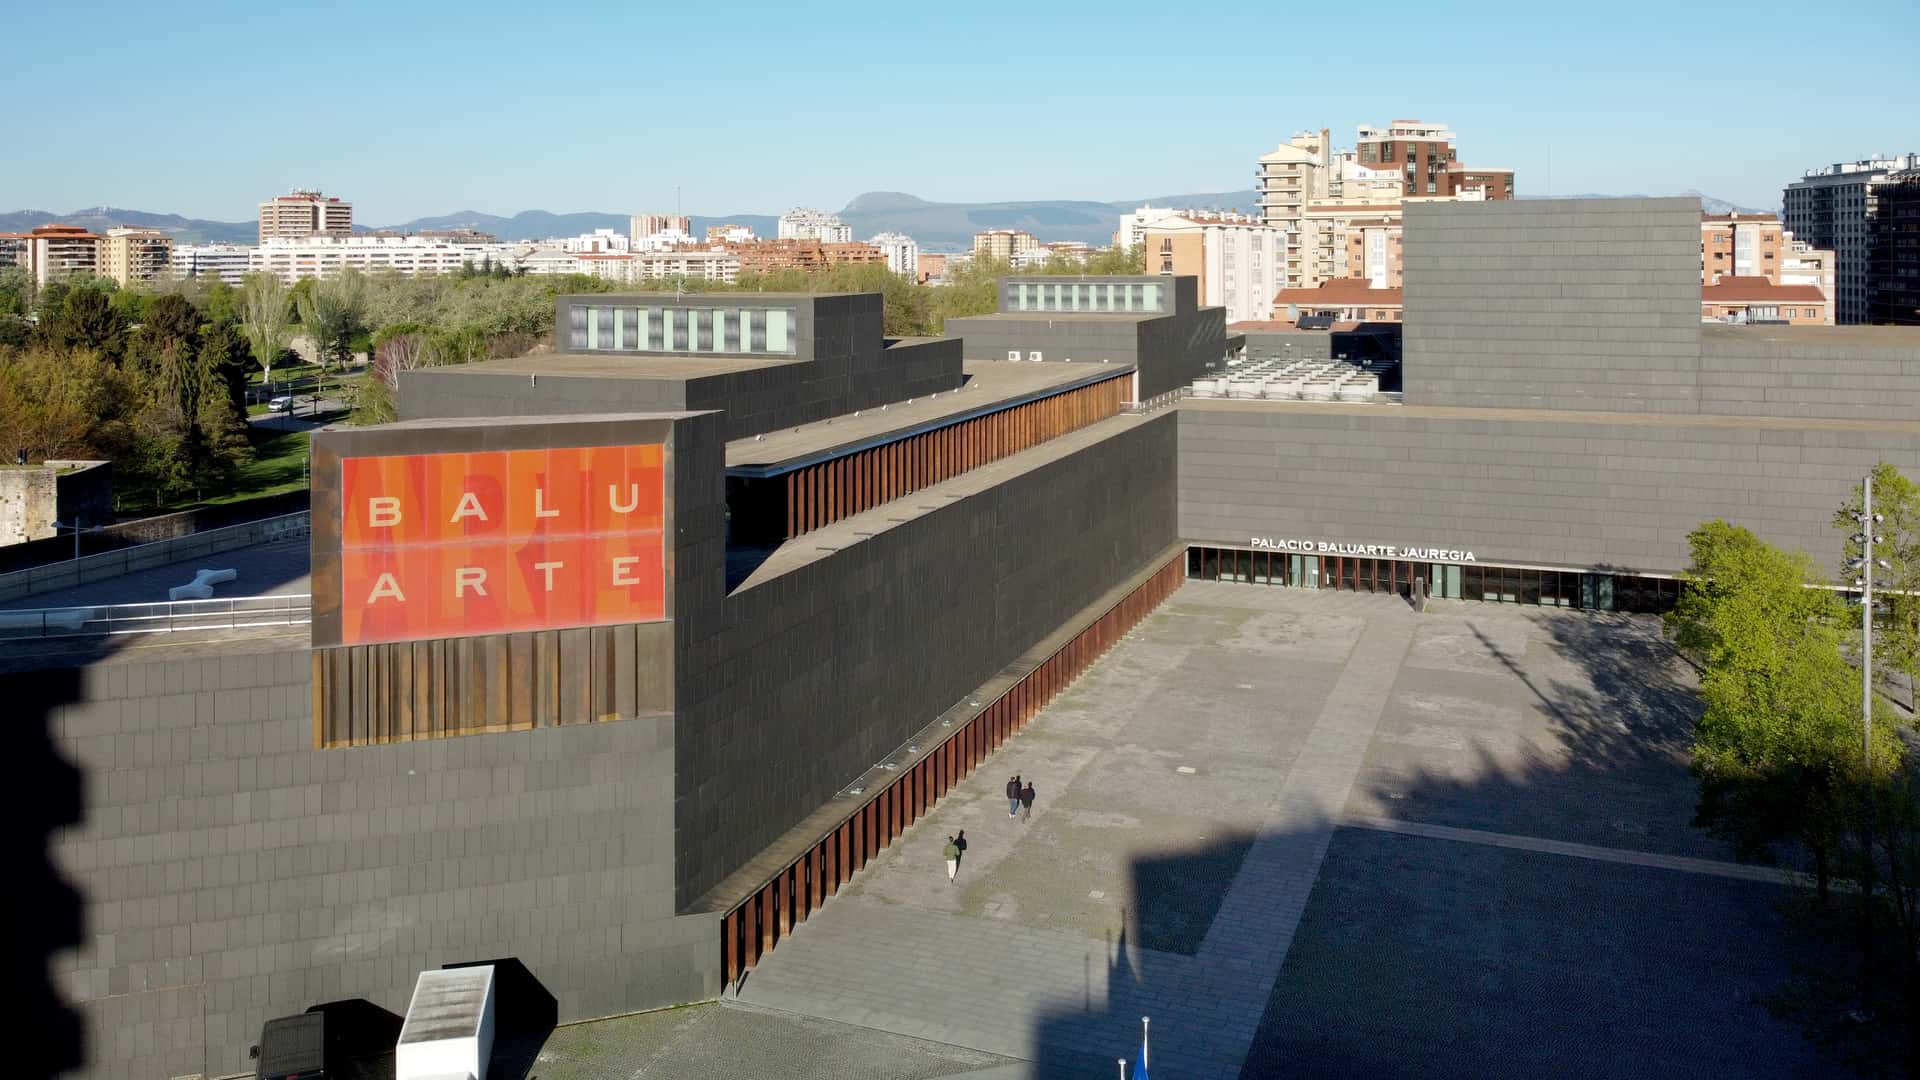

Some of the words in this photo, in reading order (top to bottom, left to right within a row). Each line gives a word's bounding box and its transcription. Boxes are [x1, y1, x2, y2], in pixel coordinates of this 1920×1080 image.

[368, 483, 639, 527] BALU
[1251, 537, 1314, 551] PALACIO
[1318, 542, 1396, 557] BALUARTE
[1400, 547, 1476, 562] JAUREGIA
[367, 556, 640, 604] ARTE
